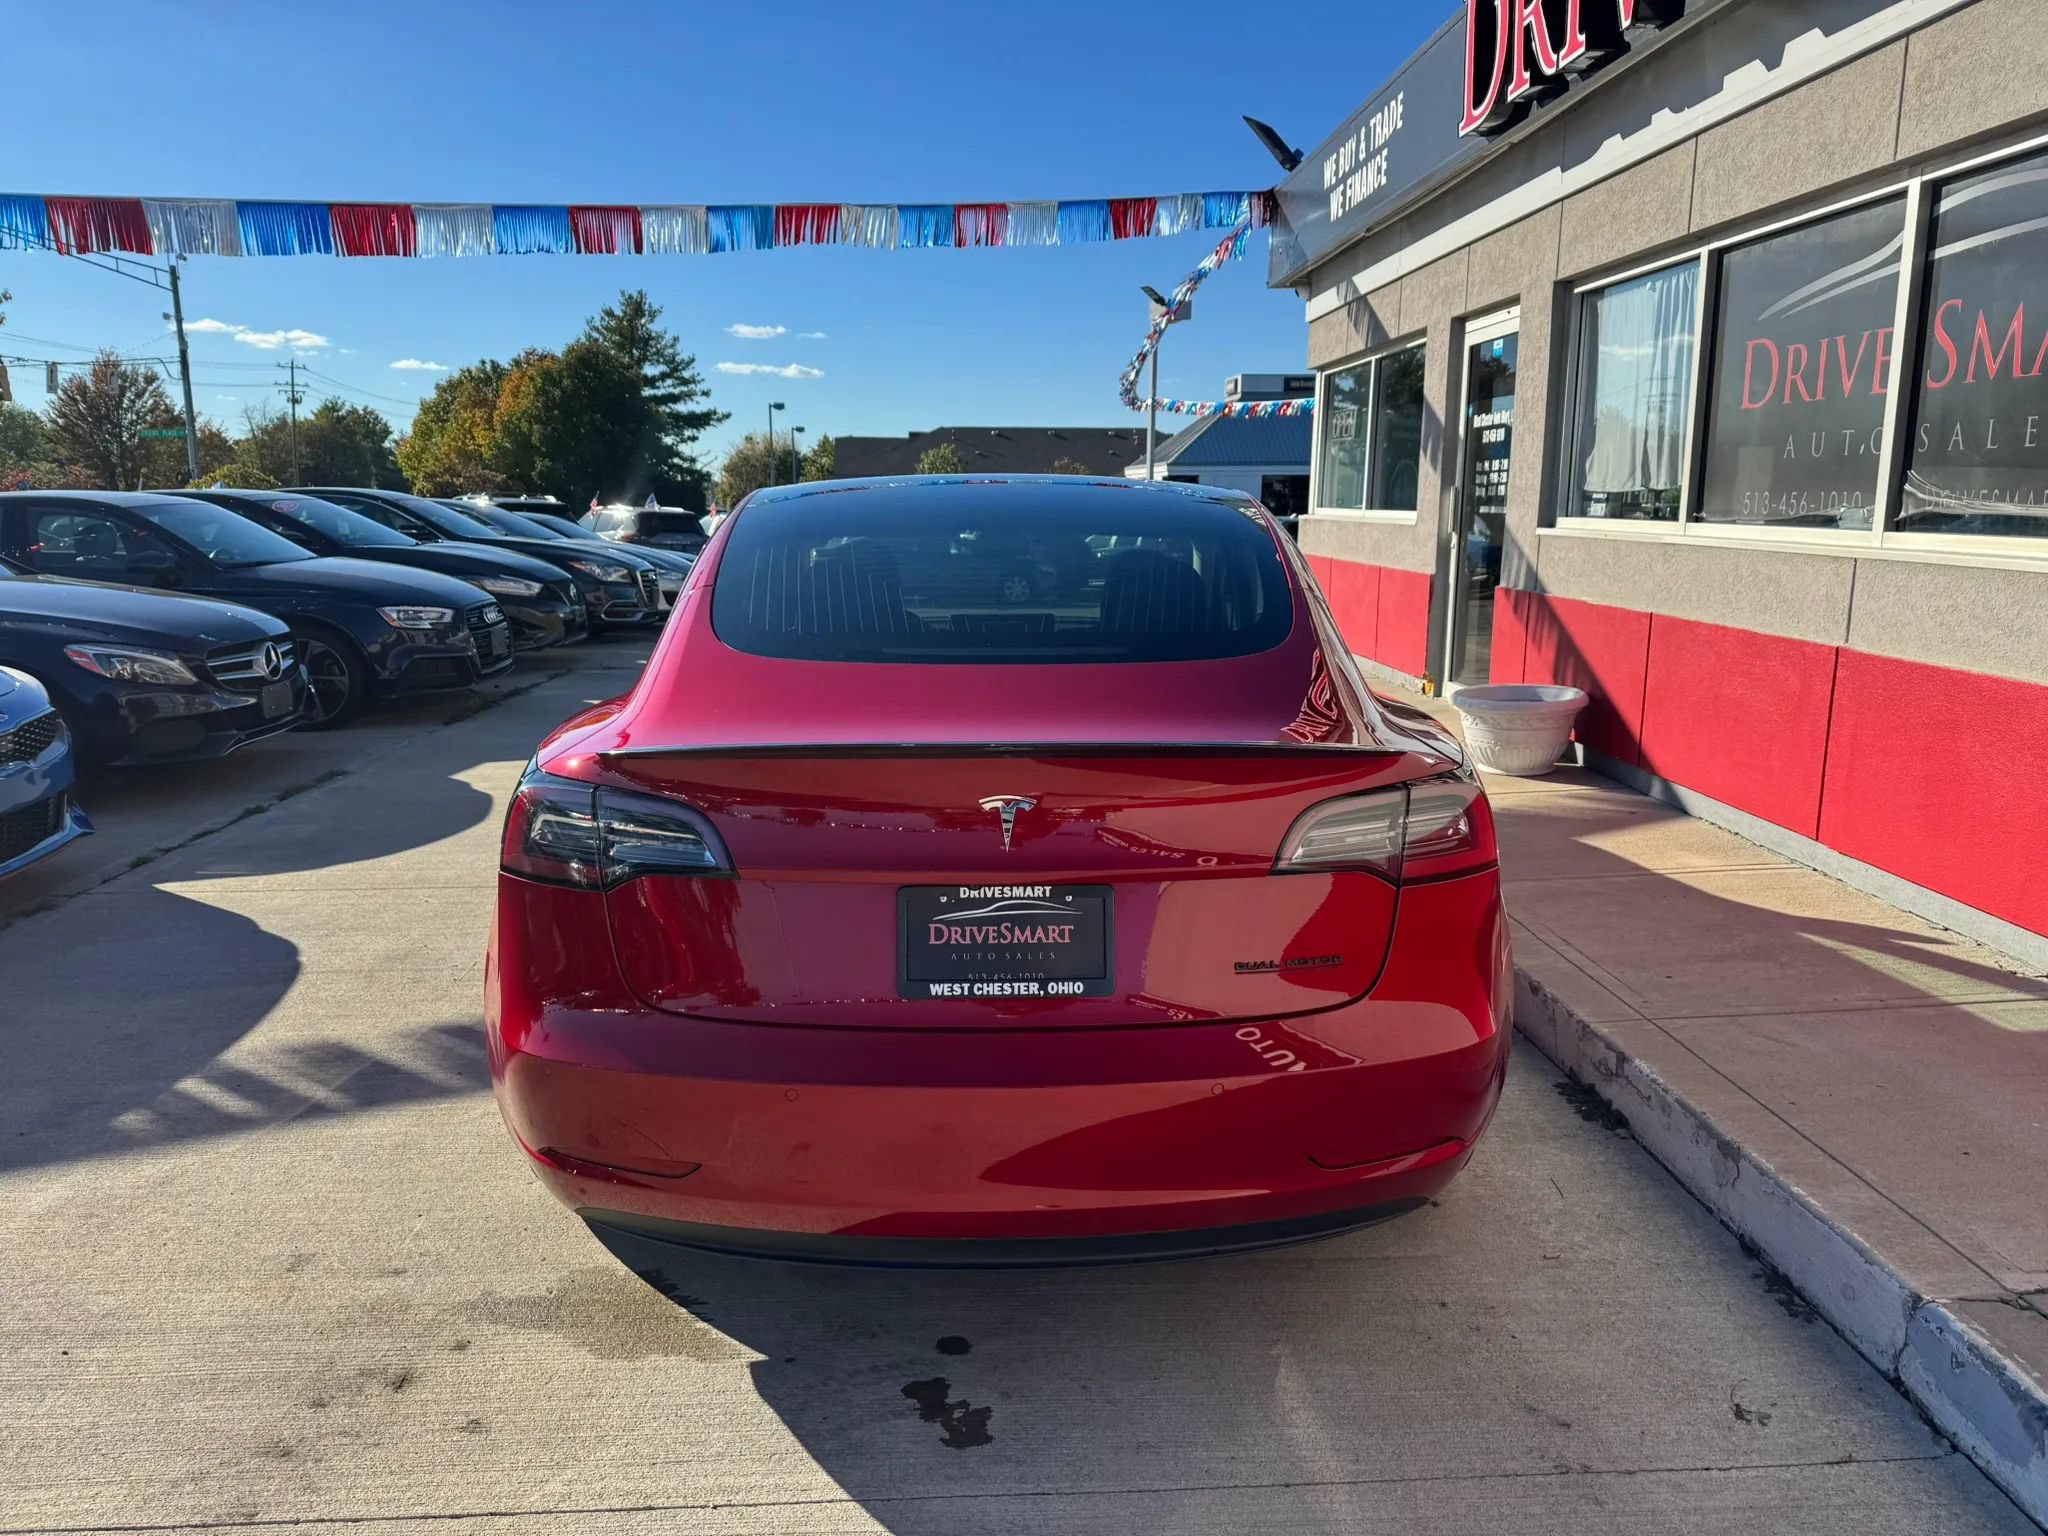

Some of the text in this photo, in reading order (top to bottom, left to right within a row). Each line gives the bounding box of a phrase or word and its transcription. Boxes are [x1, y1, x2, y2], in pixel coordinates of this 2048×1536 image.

[1323, 90, 1404, 190] WE BUY & TRADE
[1330, 147, 1388, 223] WE FINANCE
[1740, 326, 1894, 410] DRIVE
[959, 886, 1052, 899] DRIVESMART
[951, 952, 1056, 960] AUTO SALES
[1234, 955, 1344, 971] DUAL MOTOR
[929, 982, 1084, 997] WEST CHESTER, OHIO
